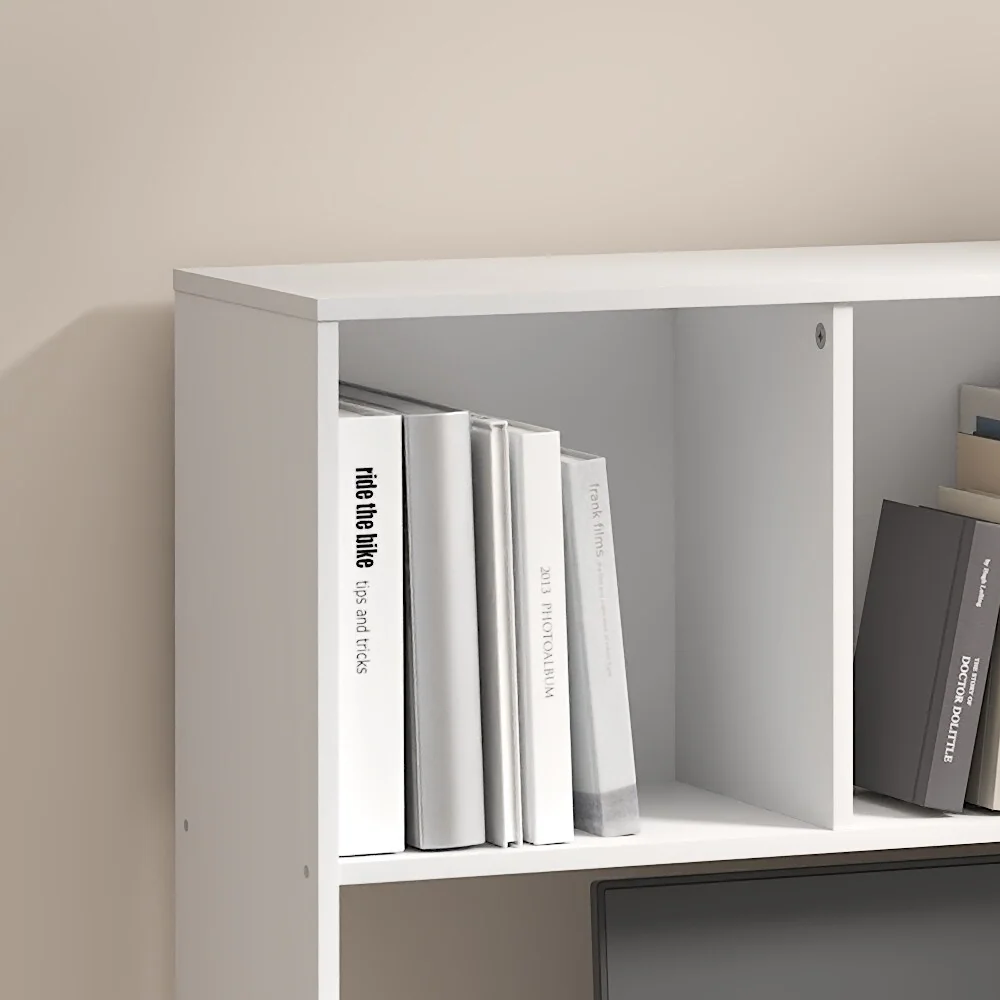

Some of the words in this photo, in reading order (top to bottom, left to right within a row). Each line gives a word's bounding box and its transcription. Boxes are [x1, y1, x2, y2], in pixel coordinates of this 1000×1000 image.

[356, 468, 377, 499] ride
[356, 503, 377, 529] the
[589, 483, 602, 519] frank
[356, 534, 377, 568] bike
[593, 523, 604, 557] films
[353, 581, 370, 604] tips
[540, 566, 551, 594] 2013
[356, 609, 370, 632] and
[356, 638, 370, 674] tricks
[541, 602, 555, 698] PHOTOALBUM
[953, 656, 971, 703] DOCTOR
[943, 706, 962, 763] DOLITTLE
